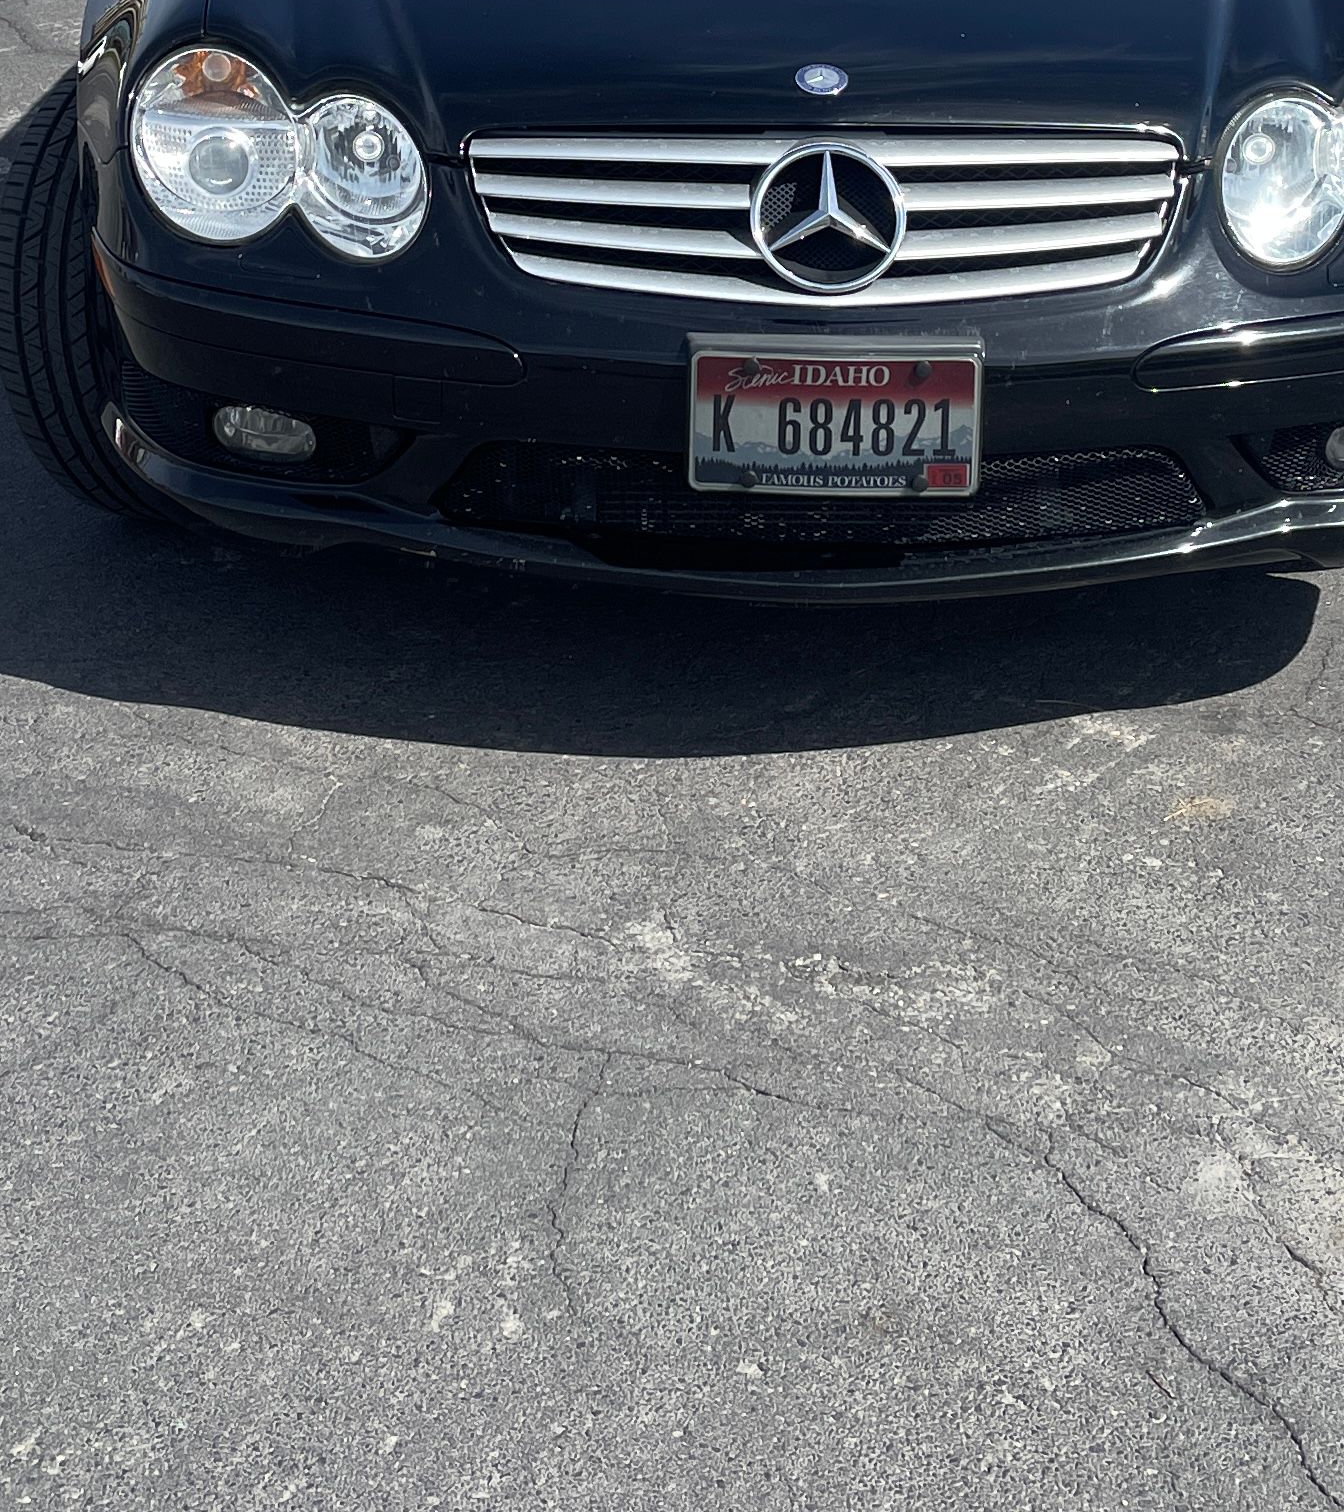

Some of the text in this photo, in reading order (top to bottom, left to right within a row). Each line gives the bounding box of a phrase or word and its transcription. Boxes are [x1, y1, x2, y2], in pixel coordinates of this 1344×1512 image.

[790, 365, 890, 387] IDAHO
[712, 394, 956, 457] K 684821
[761, 473, 906, 487] FAMOUS POTATOES
